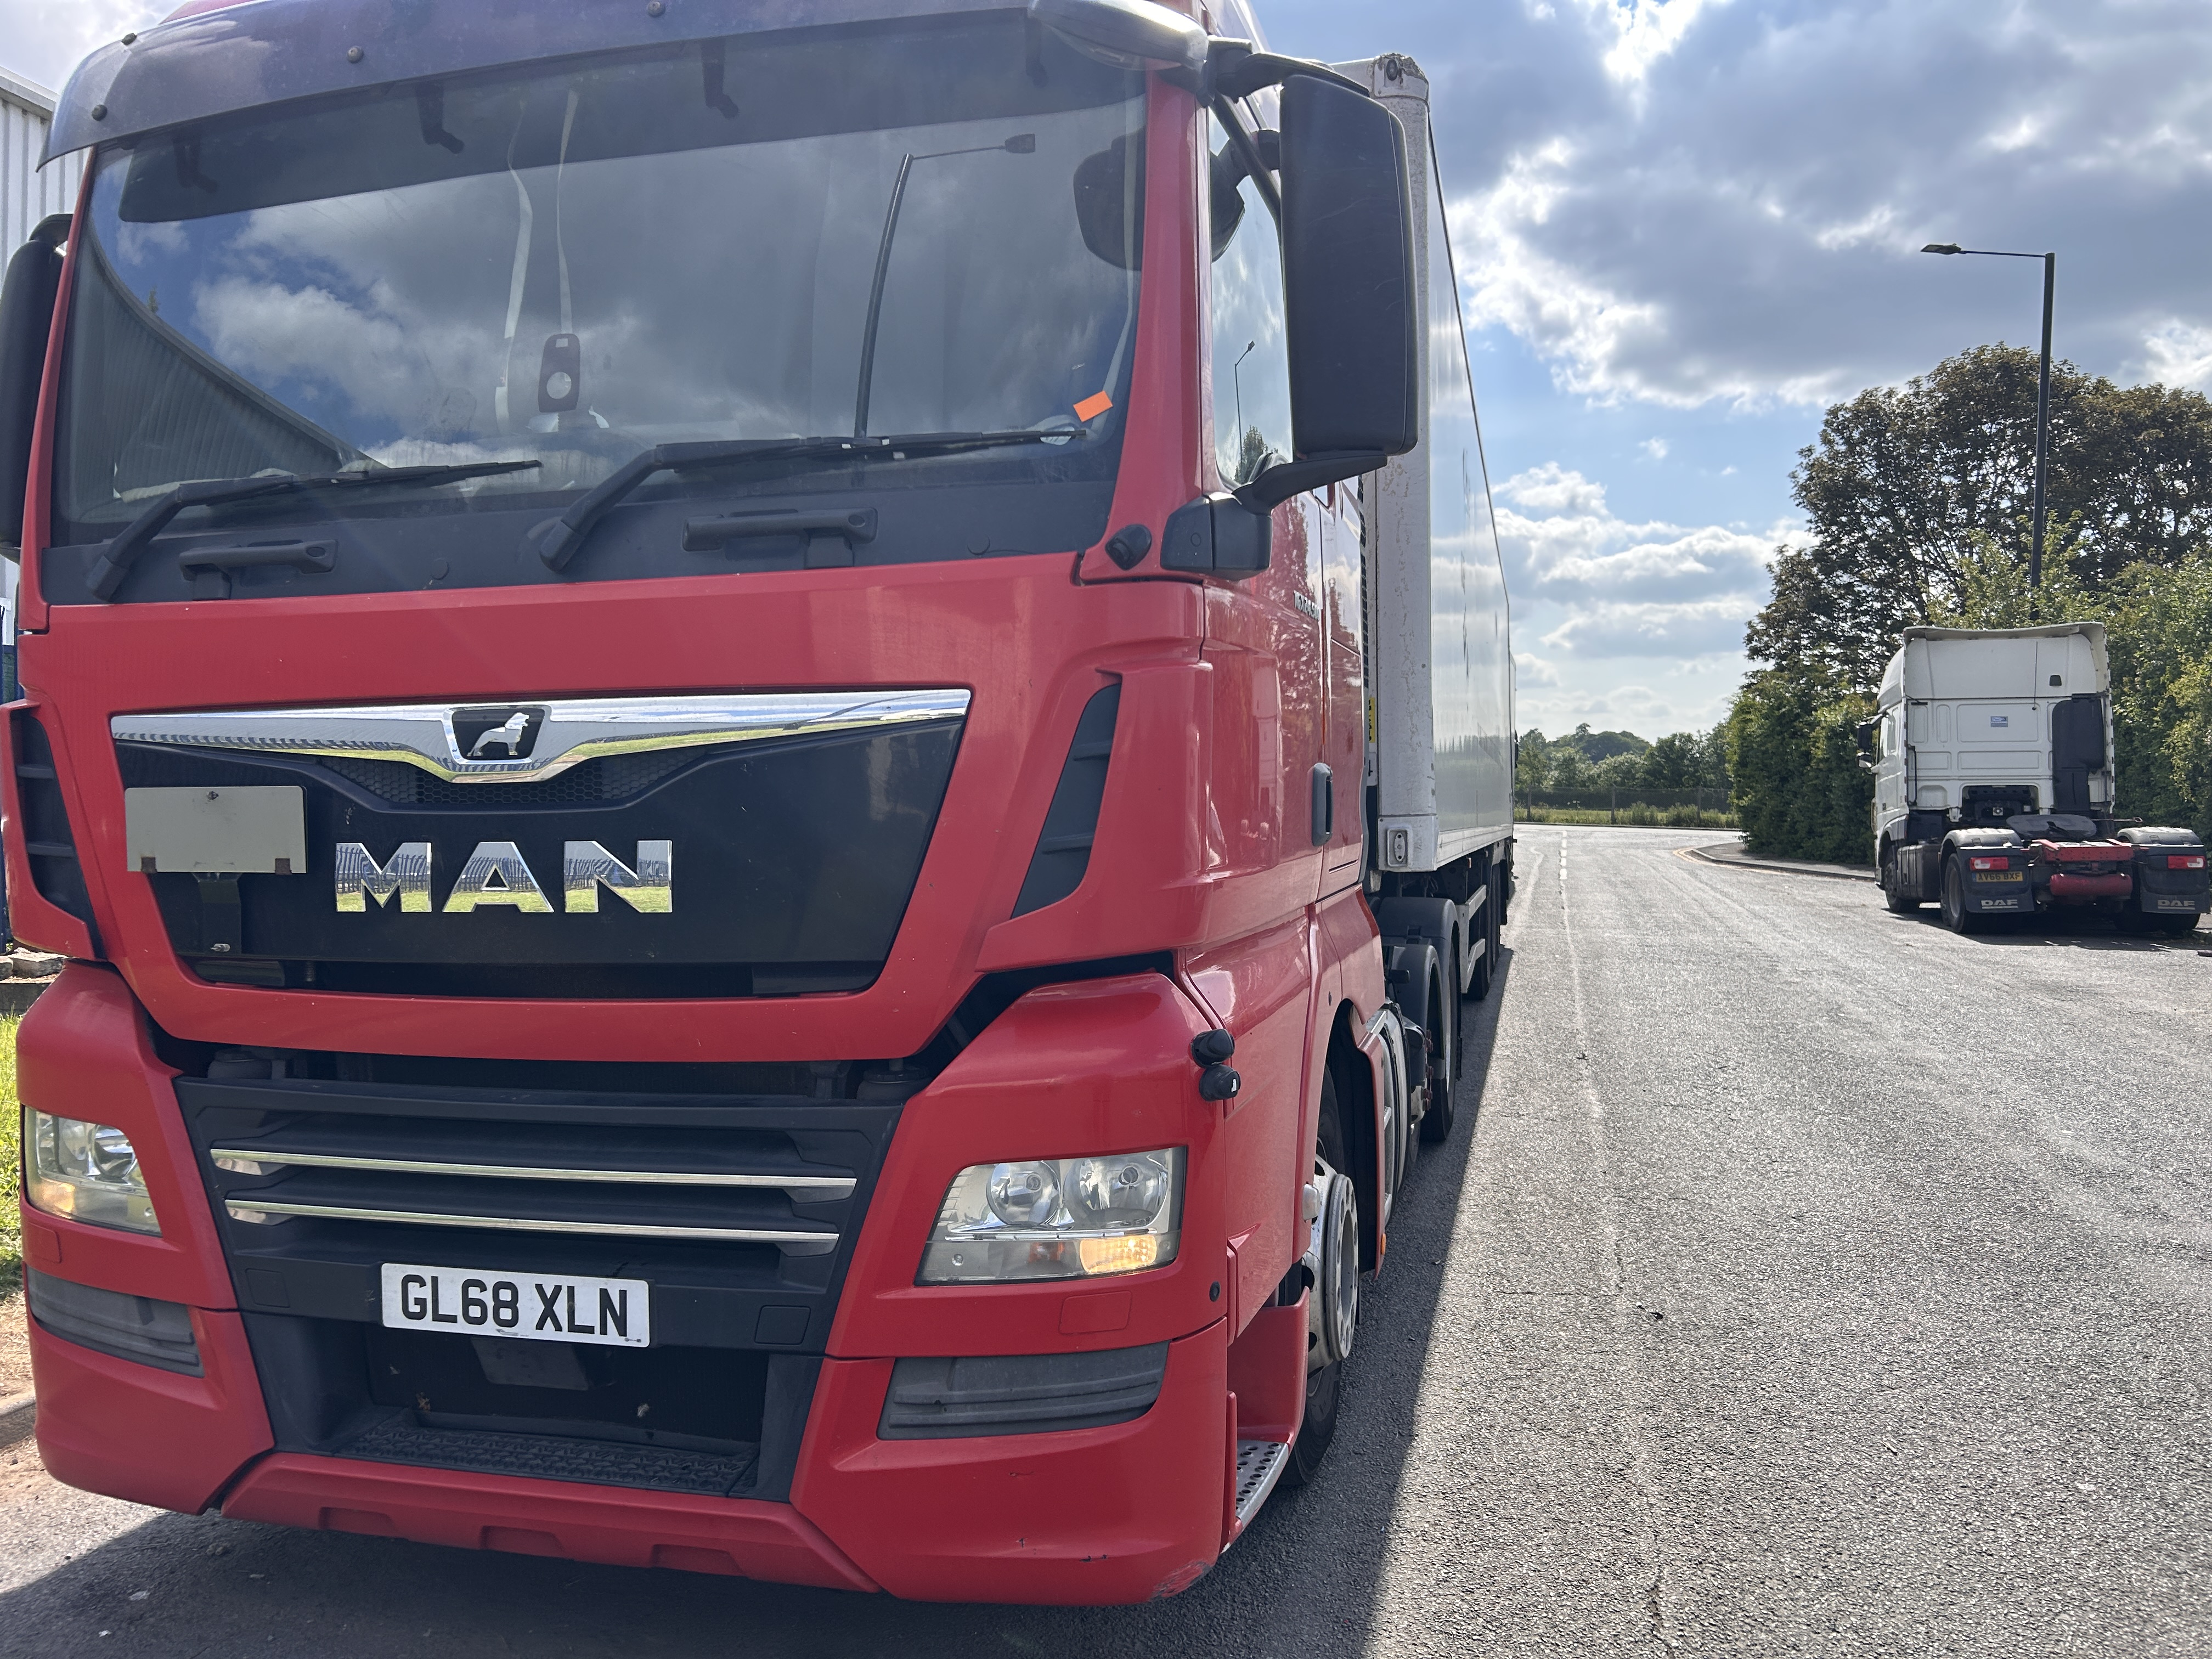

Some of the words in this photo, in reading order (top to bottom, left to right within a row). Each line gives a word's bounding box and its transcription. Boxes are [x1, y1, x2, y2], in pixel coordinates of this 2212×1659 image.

[335, 840, 673, 913] MAN
[1978, 873, 2001, 881] AV66
[2004, 872, 2021, 880] BXF
[401, 1274, 520, 1328] GL68
[535, 1283, 628, 1337] XLN
